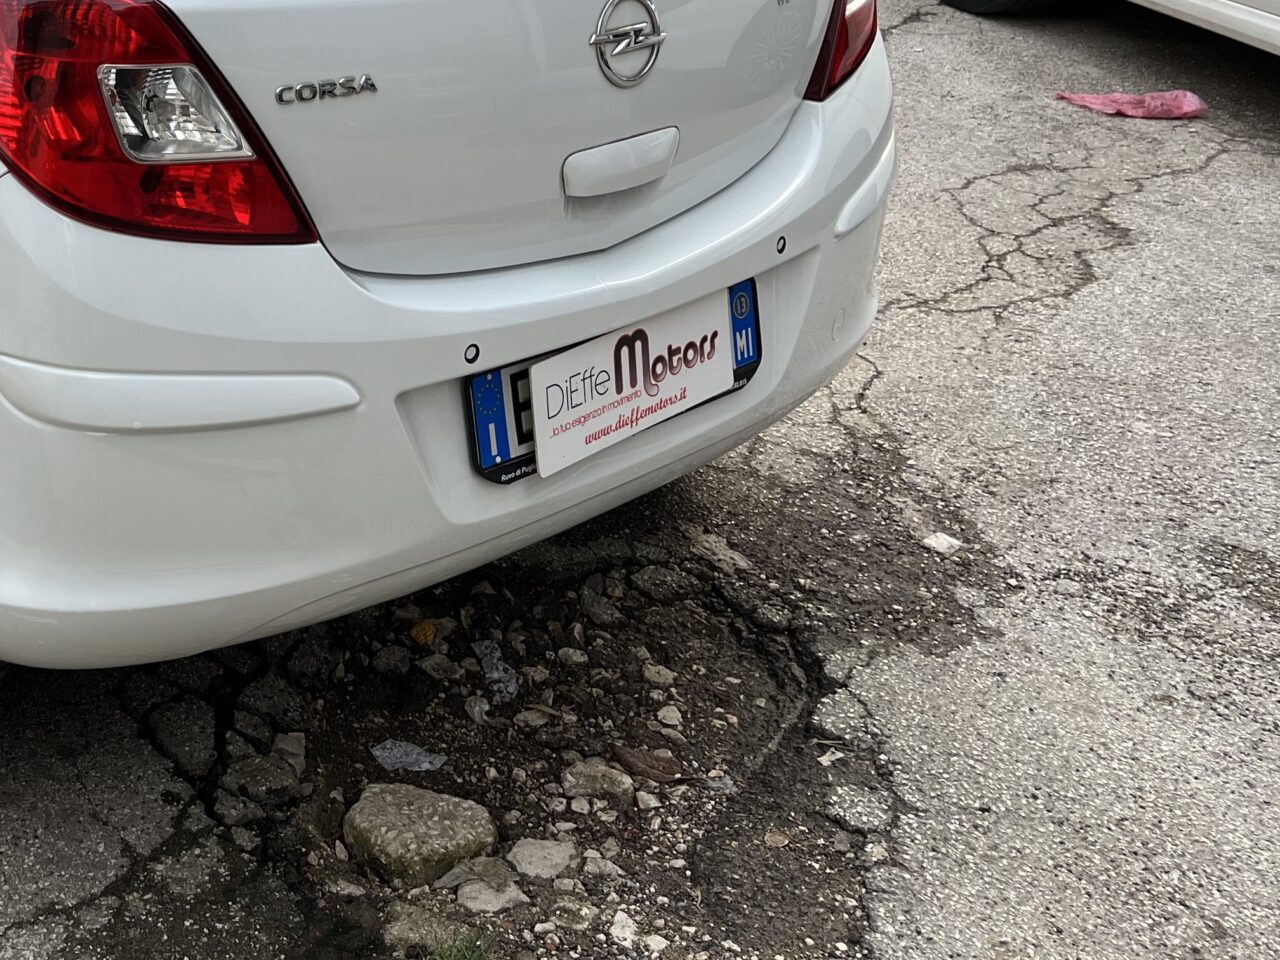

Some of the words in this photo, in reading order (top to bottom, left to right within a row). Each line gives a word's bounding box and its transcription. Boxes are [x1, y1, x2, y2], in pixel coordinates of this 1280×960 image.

[275, 74, 378, 105] CORSA
[735, 296, 748, 314] 13
[735, 327, 753, 361] MI
[545, 366, 611, 420] DiEffe
[613, 327, 719, 397] Motors
[584, 386, 688, 446] www.dieffemotors.it
